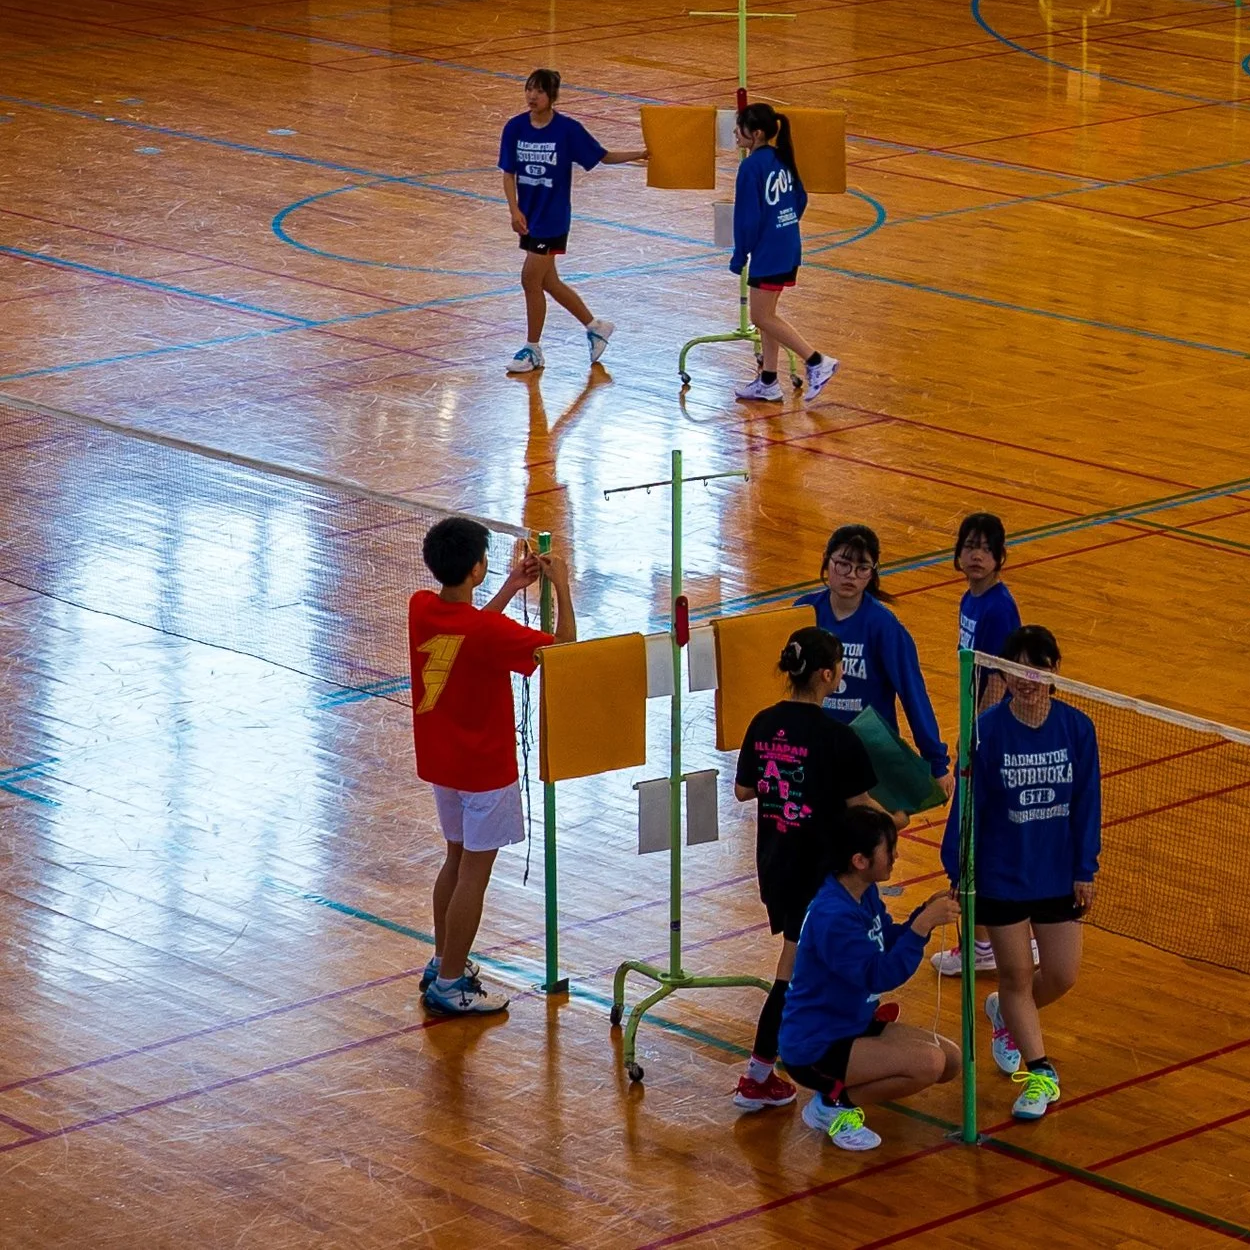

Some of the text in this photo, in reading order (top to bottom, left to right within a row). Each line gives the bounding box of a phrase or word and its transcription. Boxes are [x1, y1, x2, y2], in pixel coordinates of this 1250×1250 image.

[765, 168, 793, 206] GO!
[1003, 748, 1069, 767] BADMINTON
[763, 760, 781, 780] A
[1000, 762, 1073, 788] TSURUOKA
[1022, 789, 1052, 805] 5TH
[783, 801, 799, 820] C
